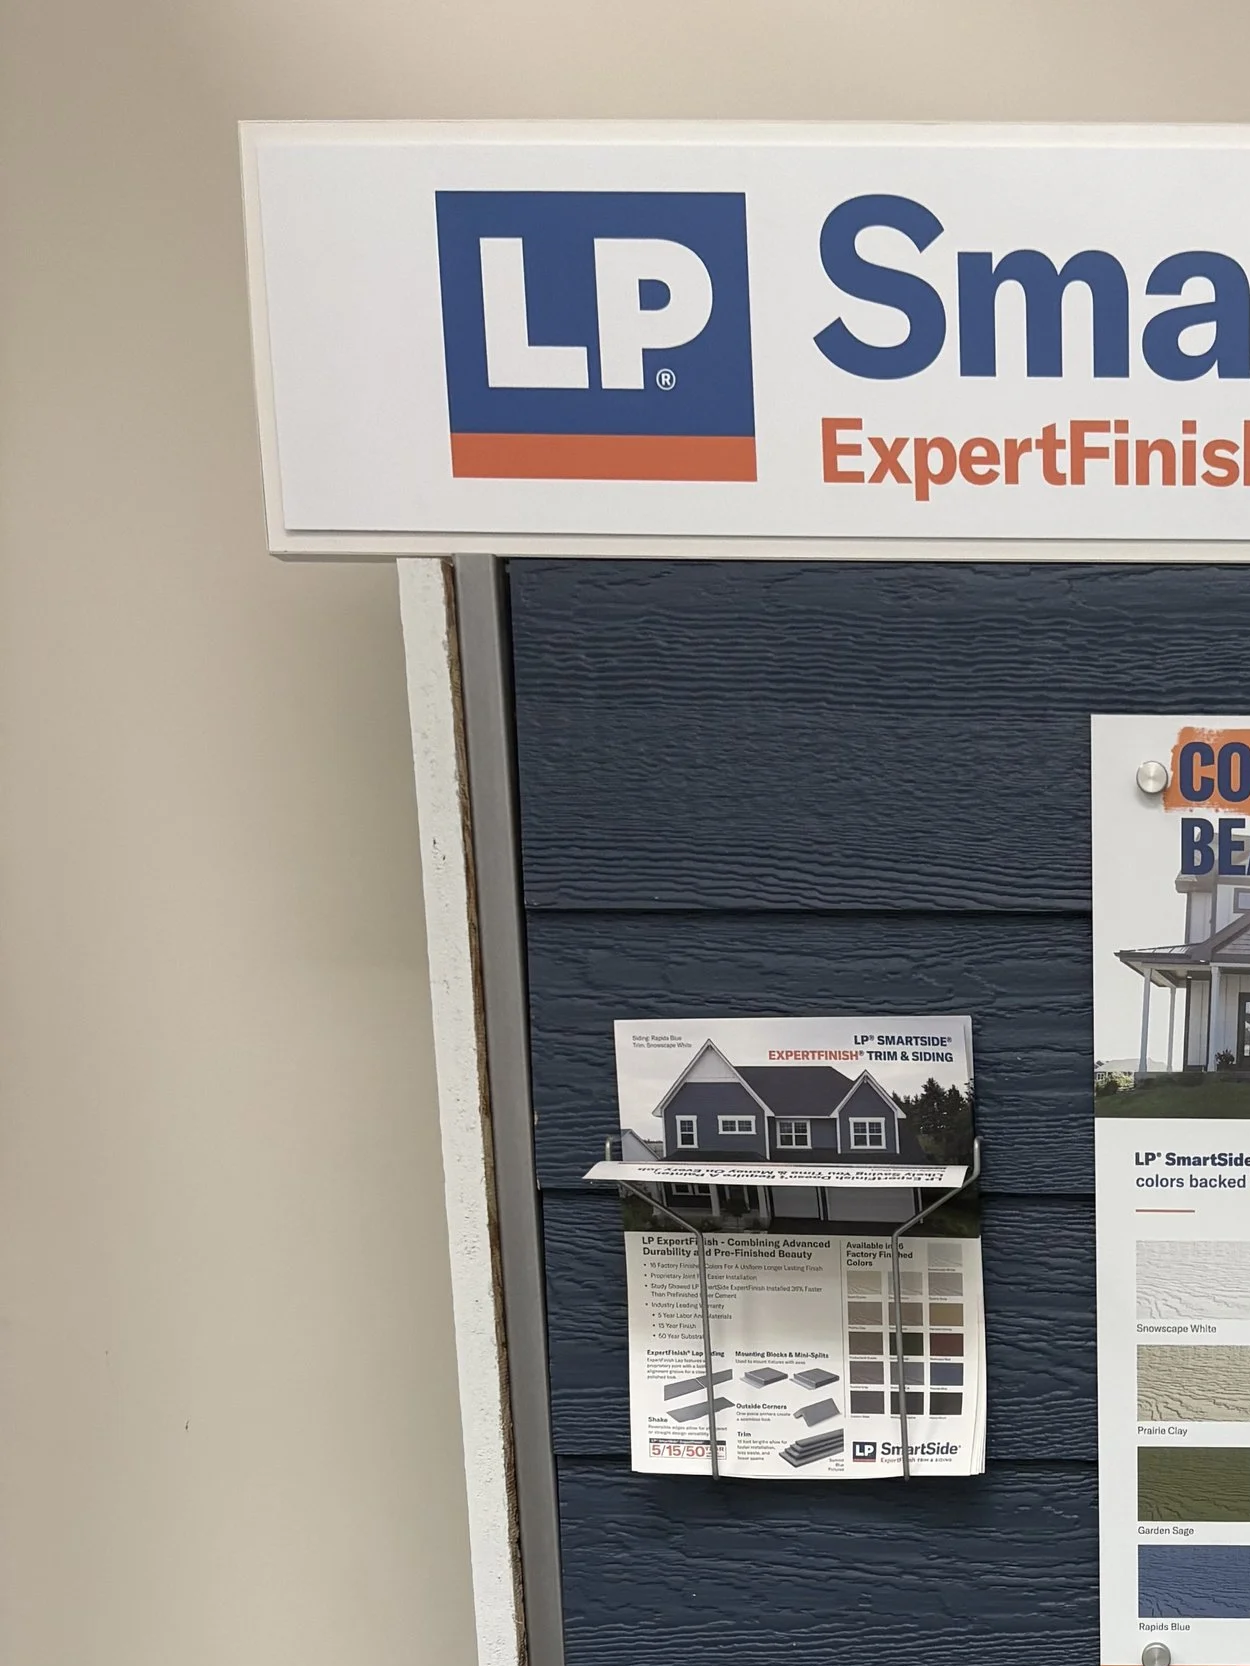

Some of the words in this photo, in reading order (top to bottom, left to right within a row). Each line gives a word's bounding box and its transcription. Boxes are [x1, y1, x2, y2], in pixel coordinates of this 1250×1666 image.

[867, 1051, 898, 1061] TRIM
[900, 1051, 909, 1061] &
[912, 1051, 954, 1062] SIDING
[1136, 1174, 1184, 1188] colors
[1189, 1174, 1246, 1188] backed
[642, 1236, 654, 1245] LP
[657, 1237, 718, 1248] ExpertFiish
[728, 1238, 780, 1249] Combining
[782, 1239, 831, 1248] Advanced
[643, 1247, 691, 1258] Durability
[714, 1248, 776, 1258] Pre-Finished
[778, 1250, 813, 1260] Beauty
[1136, 1323, 1189, 1335] Snowscape
[1190, 1324, 1217, 1333] White
[1137, 1426, 1166, 1435] Prairie
[1167, 1426, 1188, 1437] Clay
[855, 1445, 874, 1456] LP
[1138, 1526, 1170, 1535] Garden
[1172, 1526, 1194, 1537] Sage
[1138, 1622, 1169, 1632] Rapids
[1170, 1622, 1190, 1631] Blue
